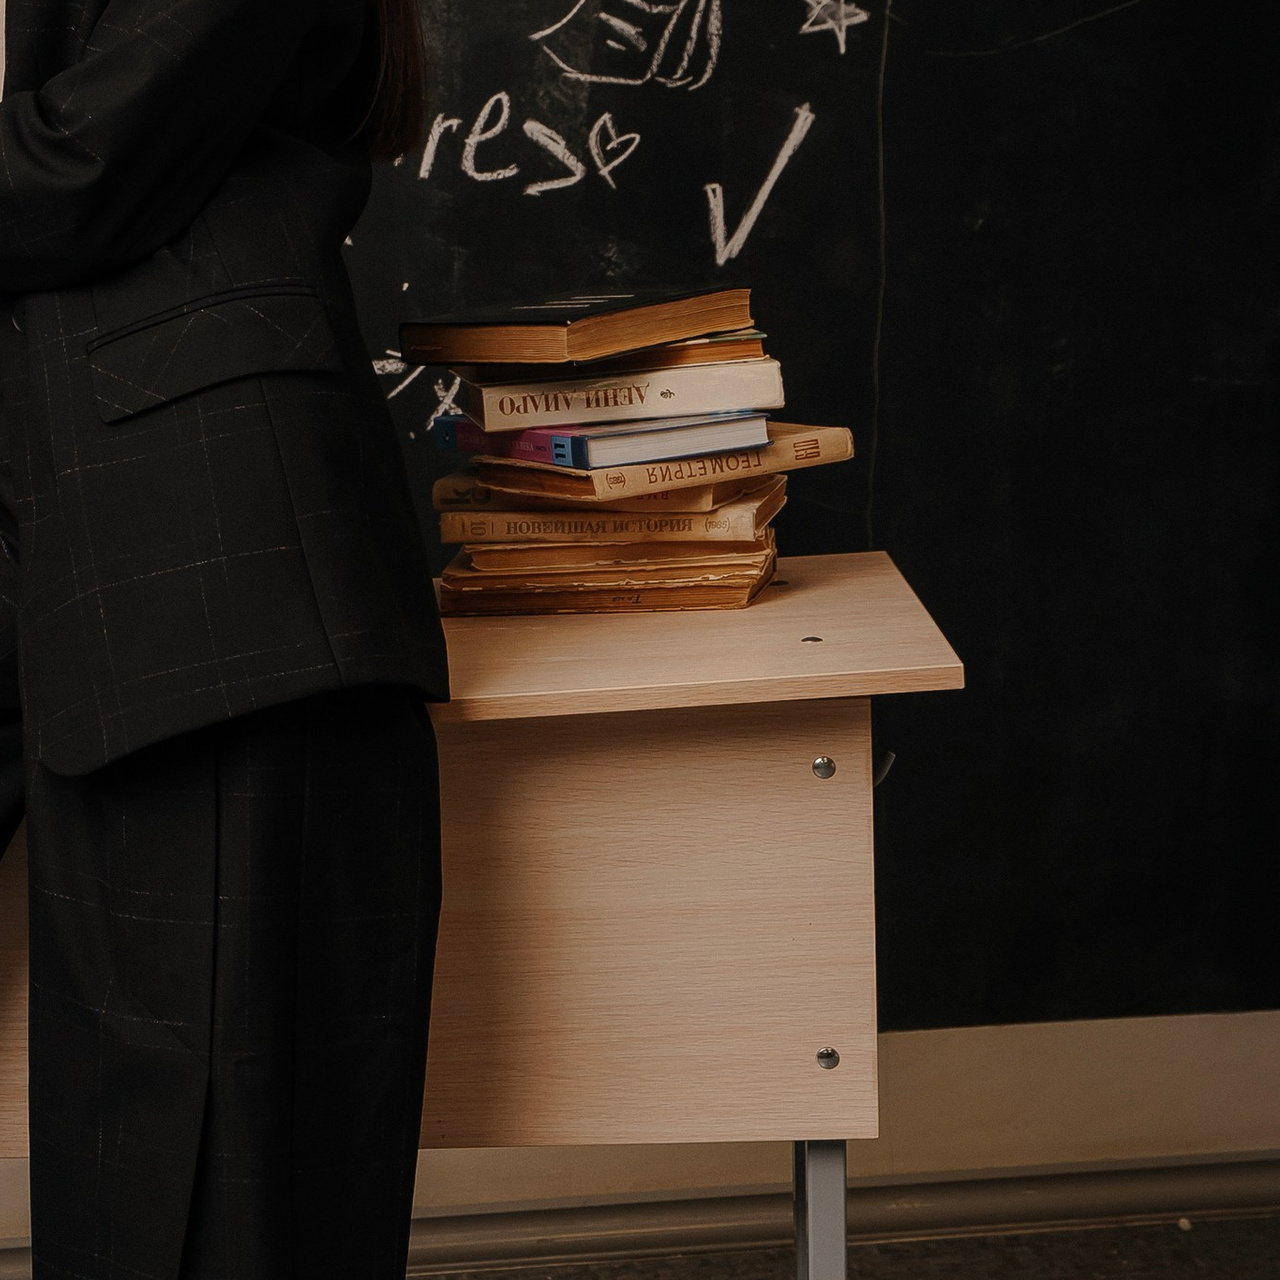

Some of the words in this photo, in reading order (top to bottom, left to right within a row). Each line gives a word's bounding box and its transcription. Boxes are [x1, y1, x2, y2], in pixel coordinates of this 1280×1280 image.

[647, 450, 764, 485] ГЕОМЕТРИЯ
[505, 516, 609, 536] НОВЕЙШАЯ
[612, 517, 695, 535] ИСТОРИЯ
